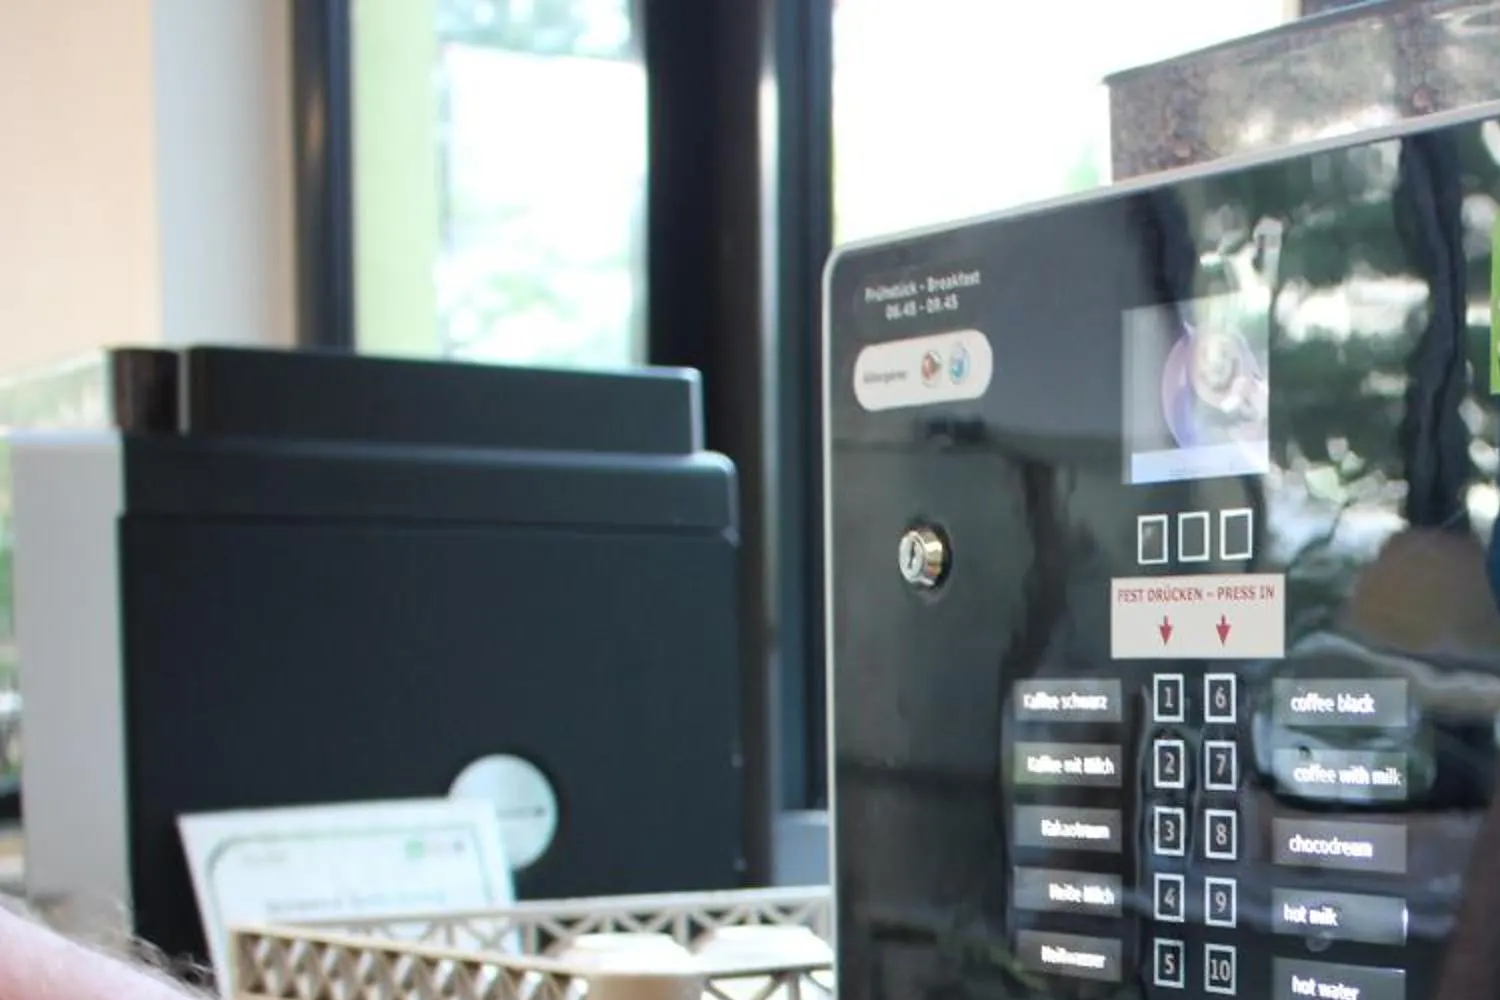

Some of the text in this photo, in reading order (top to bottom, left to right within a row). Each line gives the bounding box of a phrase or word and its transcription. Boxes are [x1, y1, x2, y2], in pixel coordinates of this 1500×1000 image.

[1118, 588, 1143, 602] FEST
[1147, 584, 1203, 602] DRÜCKEN
[1217, 586, 1256, 600] PRESS
[1260, 585, 1275, 599] IN
[1215, 687, 1226, 709] 6
[1291, 693, 1374, 712] coffee black
[1164, 752, 1175, 774] 2
[1215, 754, 1226, 776] 7
[1293, 764, 1400, 784] coffee with milk
[1163, 820, 1175, 841] 3
[1215, 823, 1227, 845] 8
[1290, 835, 1372, 857] chocodream
[1164, 887, 1175, 908] 4
[1215, 892, 1227, 913] 9
[1284, 904, 1306, 922] hot
[1164, 953, 1175, 975] 5
[1210, 958, 1231, 982] 10
[1293, 976, 1358, 1000] hot water
